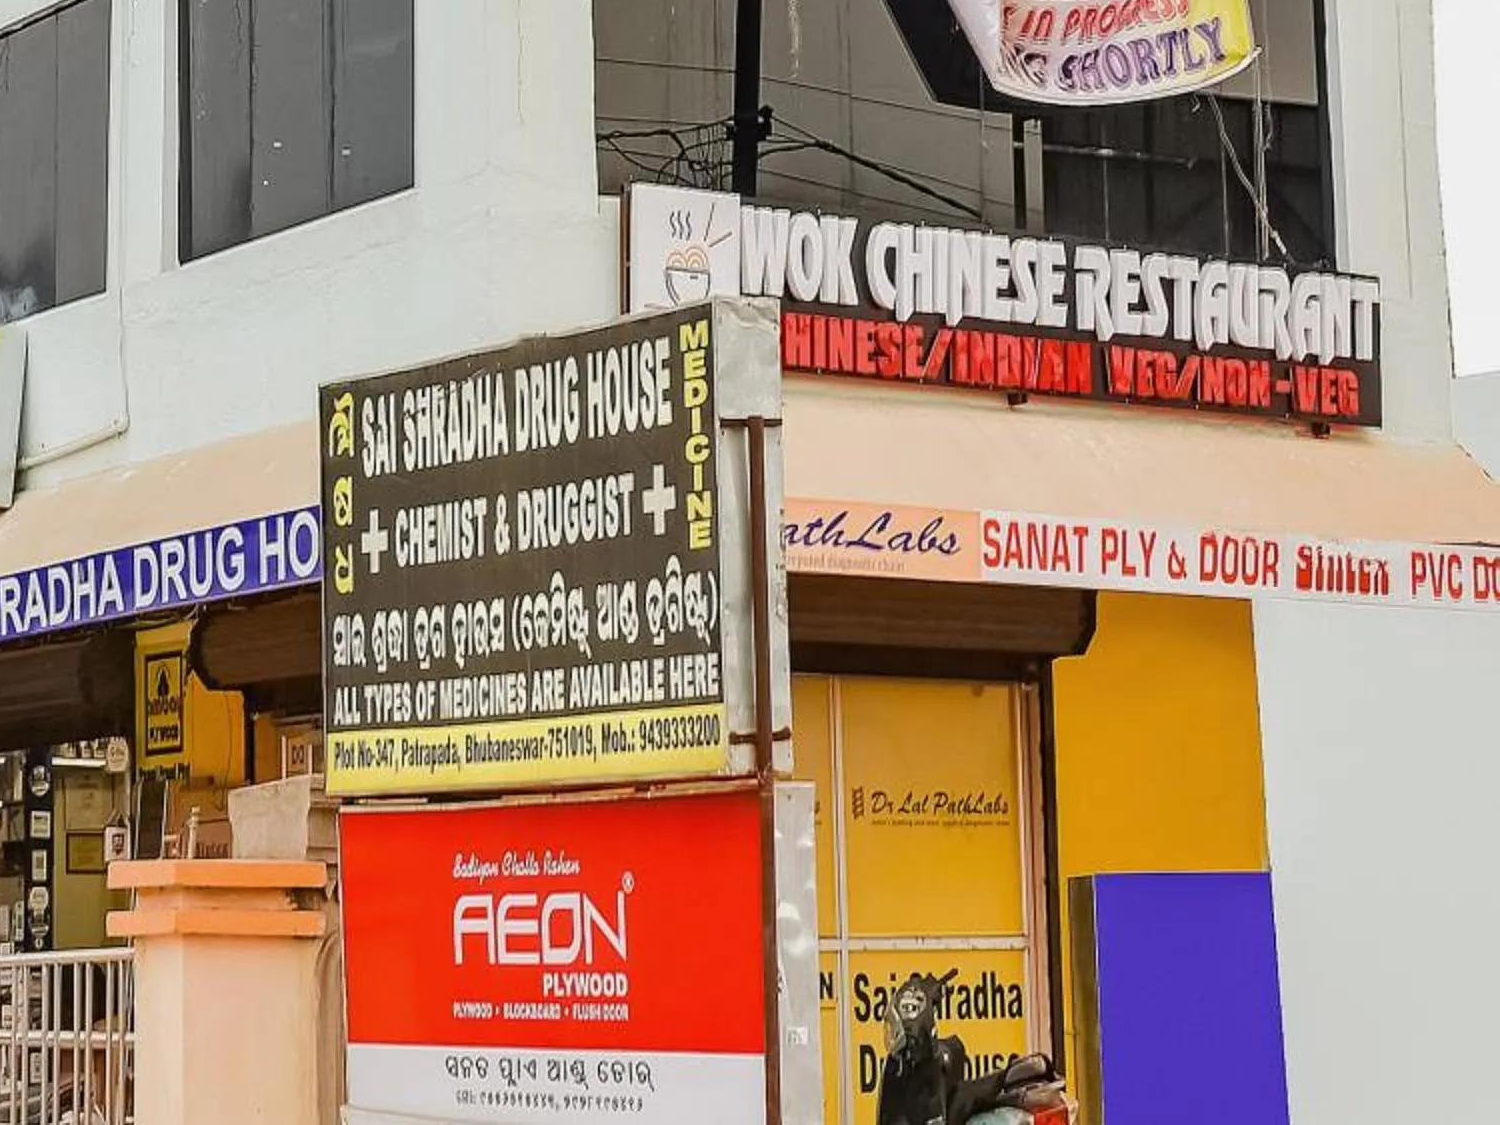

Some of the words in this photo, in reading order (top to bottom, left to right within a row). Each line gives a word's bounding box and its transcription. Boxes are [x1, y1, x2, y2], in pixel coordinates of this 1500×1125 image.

[1021, 8, 1054, 38] IN
[1058, 17, 1225, 92] SHORTLY
[741, 205, 859, 306] WOK
[866, 221, 1068, 328] CHINESE
[1074, 245, 1379, 365] RESTAURANT
[782, 312, 1091, 394] HINESE/INDIAN
[361, 394, 397, 477] SAI
[402, 370, 509, 472] SHRADHA
[514, 355, 581, 453] DRUG
[587, 336, 673, 438] HOUSE
[679, 319, 713, 550] MEDICINE
[395, 497, 486, 568] CHEMIST
[495, 493, 511, 555] &
[517, 472, 634, 552] DRUGGIST
[784, 510, 961, 555] athLabs
[982, 518, 1090, 574] SANAT
[1100, 525, 1156, 579] PLY
[1167, 541, 1188, 581] &
[1199, 531, 1280, 588] DOOR
[1411, 550, 1463, 600] PVC
[133, 525, 244, 609] DRUG
[333, 687, 361, 727] ALL
[364, 680, 411, 723] TYPES
[416, 678, 436, 719] OF
[440, 671, 527, 718] MEDICINES
[531, 666, 565, 712] ARE
[570, 657, 665, 709] AVAILABLE
[669, 652, 719, 699] HERE
[401, 734, 461, 774] Patrapada,
[639, 713, 721, 751] 9439333200
[871, 789, 893, 815] Dr
[898, 790, 929, 815] Lal
[932, 790, 1009, 816] PathLabs
[453, 891, 629, 966] AEON
[543, 972, 628, 998] PLYWOOD
